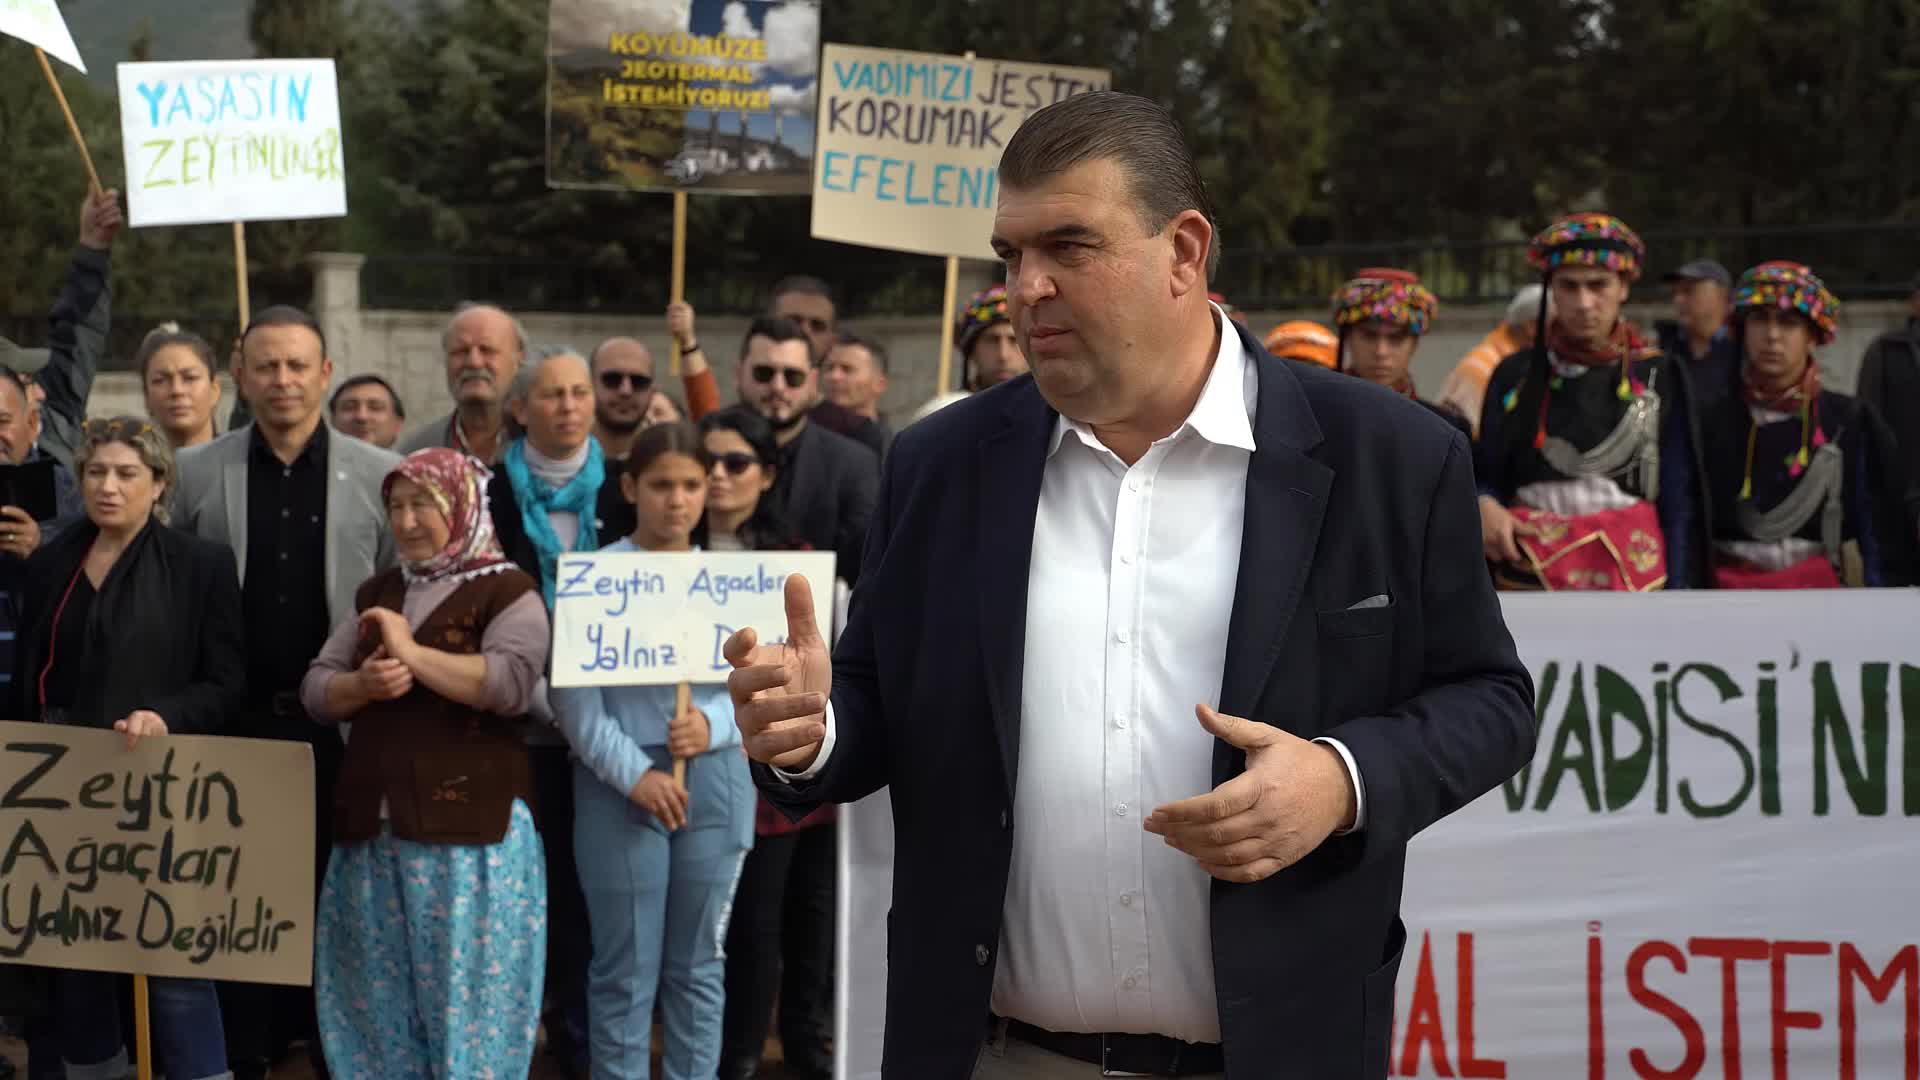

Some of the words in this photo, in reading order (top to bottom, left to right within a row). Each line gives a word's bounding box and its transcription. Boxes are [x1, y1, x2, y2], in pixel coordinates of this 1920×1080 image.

[610, 31, 768, 61] KÖYÜMÜZE
[622, 59, 752, 83] JEOTERMAL
[827, 96, 1005, 149] KORUMAK
[556, 561, 664, 616] Zeytin
[688, 565, 785, 605] Ağaçlar
[580, 623, 678, 671] Yalnız
[0, 743, 243, 831] Zeytin
[0, 819, 241, 892] Ağaçları
[0, 883, 128, 957] Yalnız
[136, 889, 296, 965] Değildir
[1387, 928, 1506, 1080] AL
